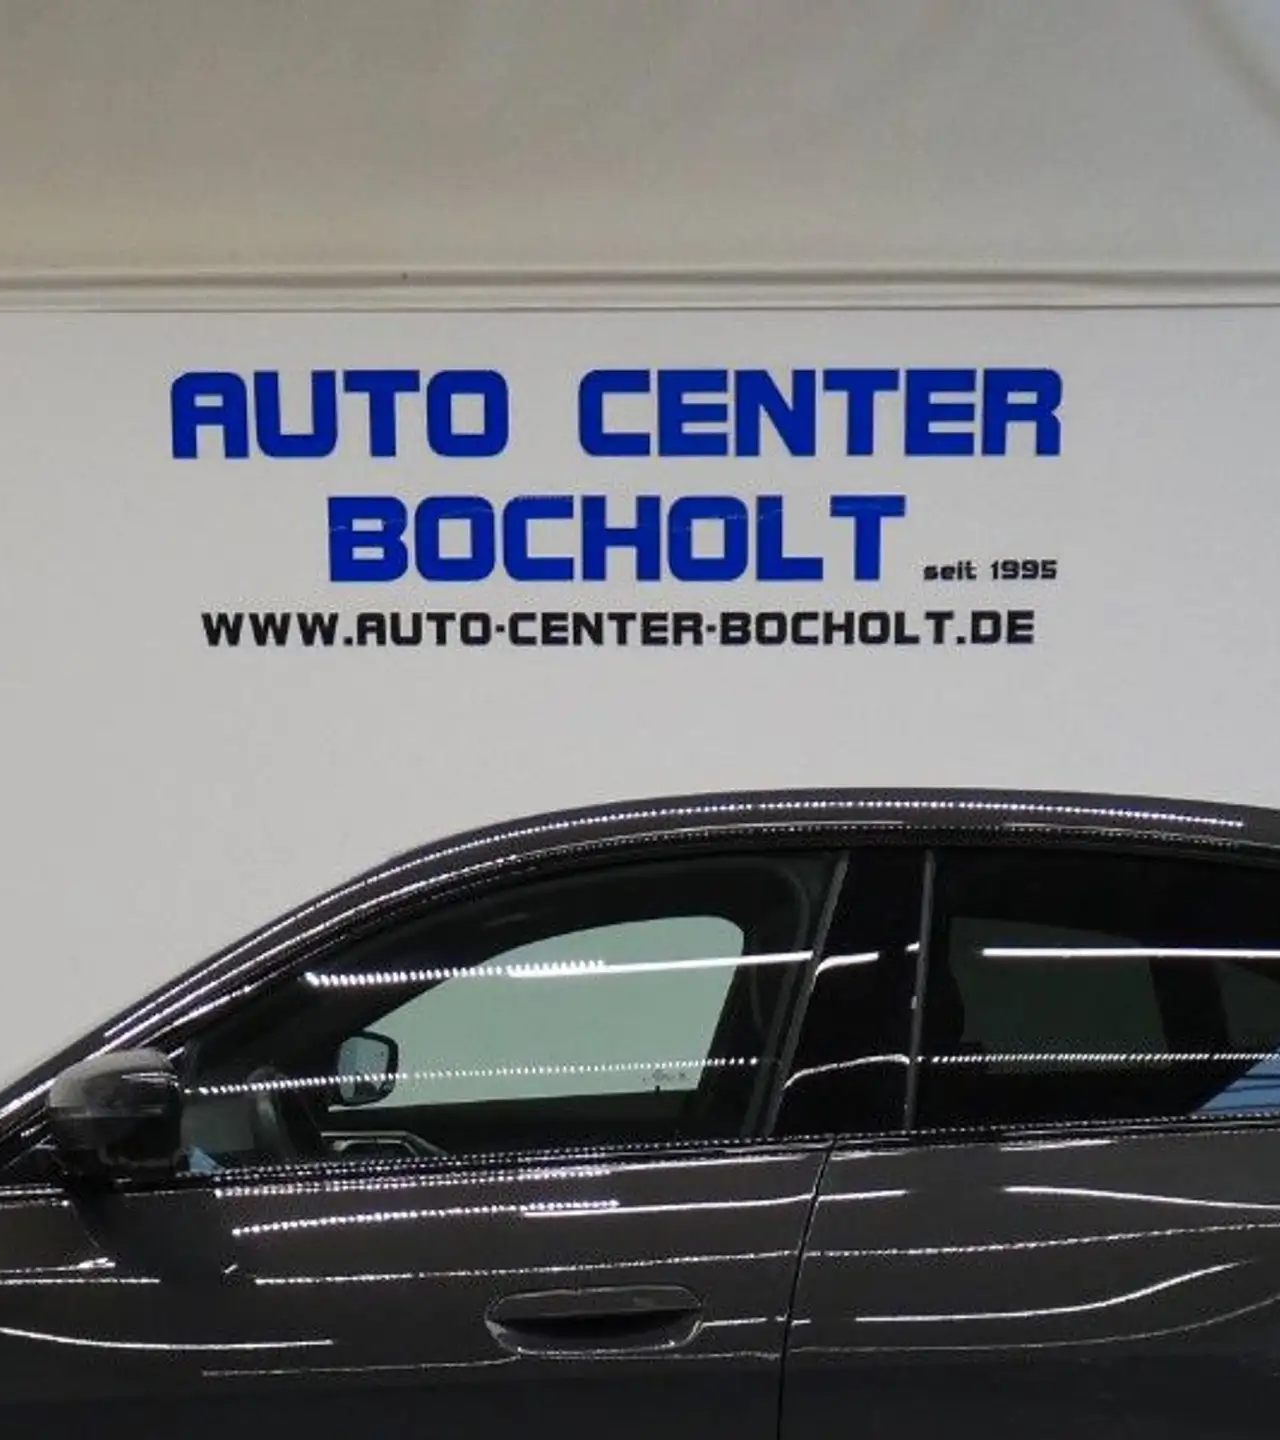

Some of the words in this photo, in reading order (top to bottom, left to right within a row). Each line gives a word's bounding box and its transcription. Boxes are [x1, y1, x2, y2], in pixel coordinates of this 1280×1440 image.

[170, 368, 510, 461] AUTO
[578, 367, 1063, 459] CENTER
[327, 493, 908, 585] BOCHOLT
[923, 559, 977, 580] seit
[990, 559, 1057, 580] 1995
